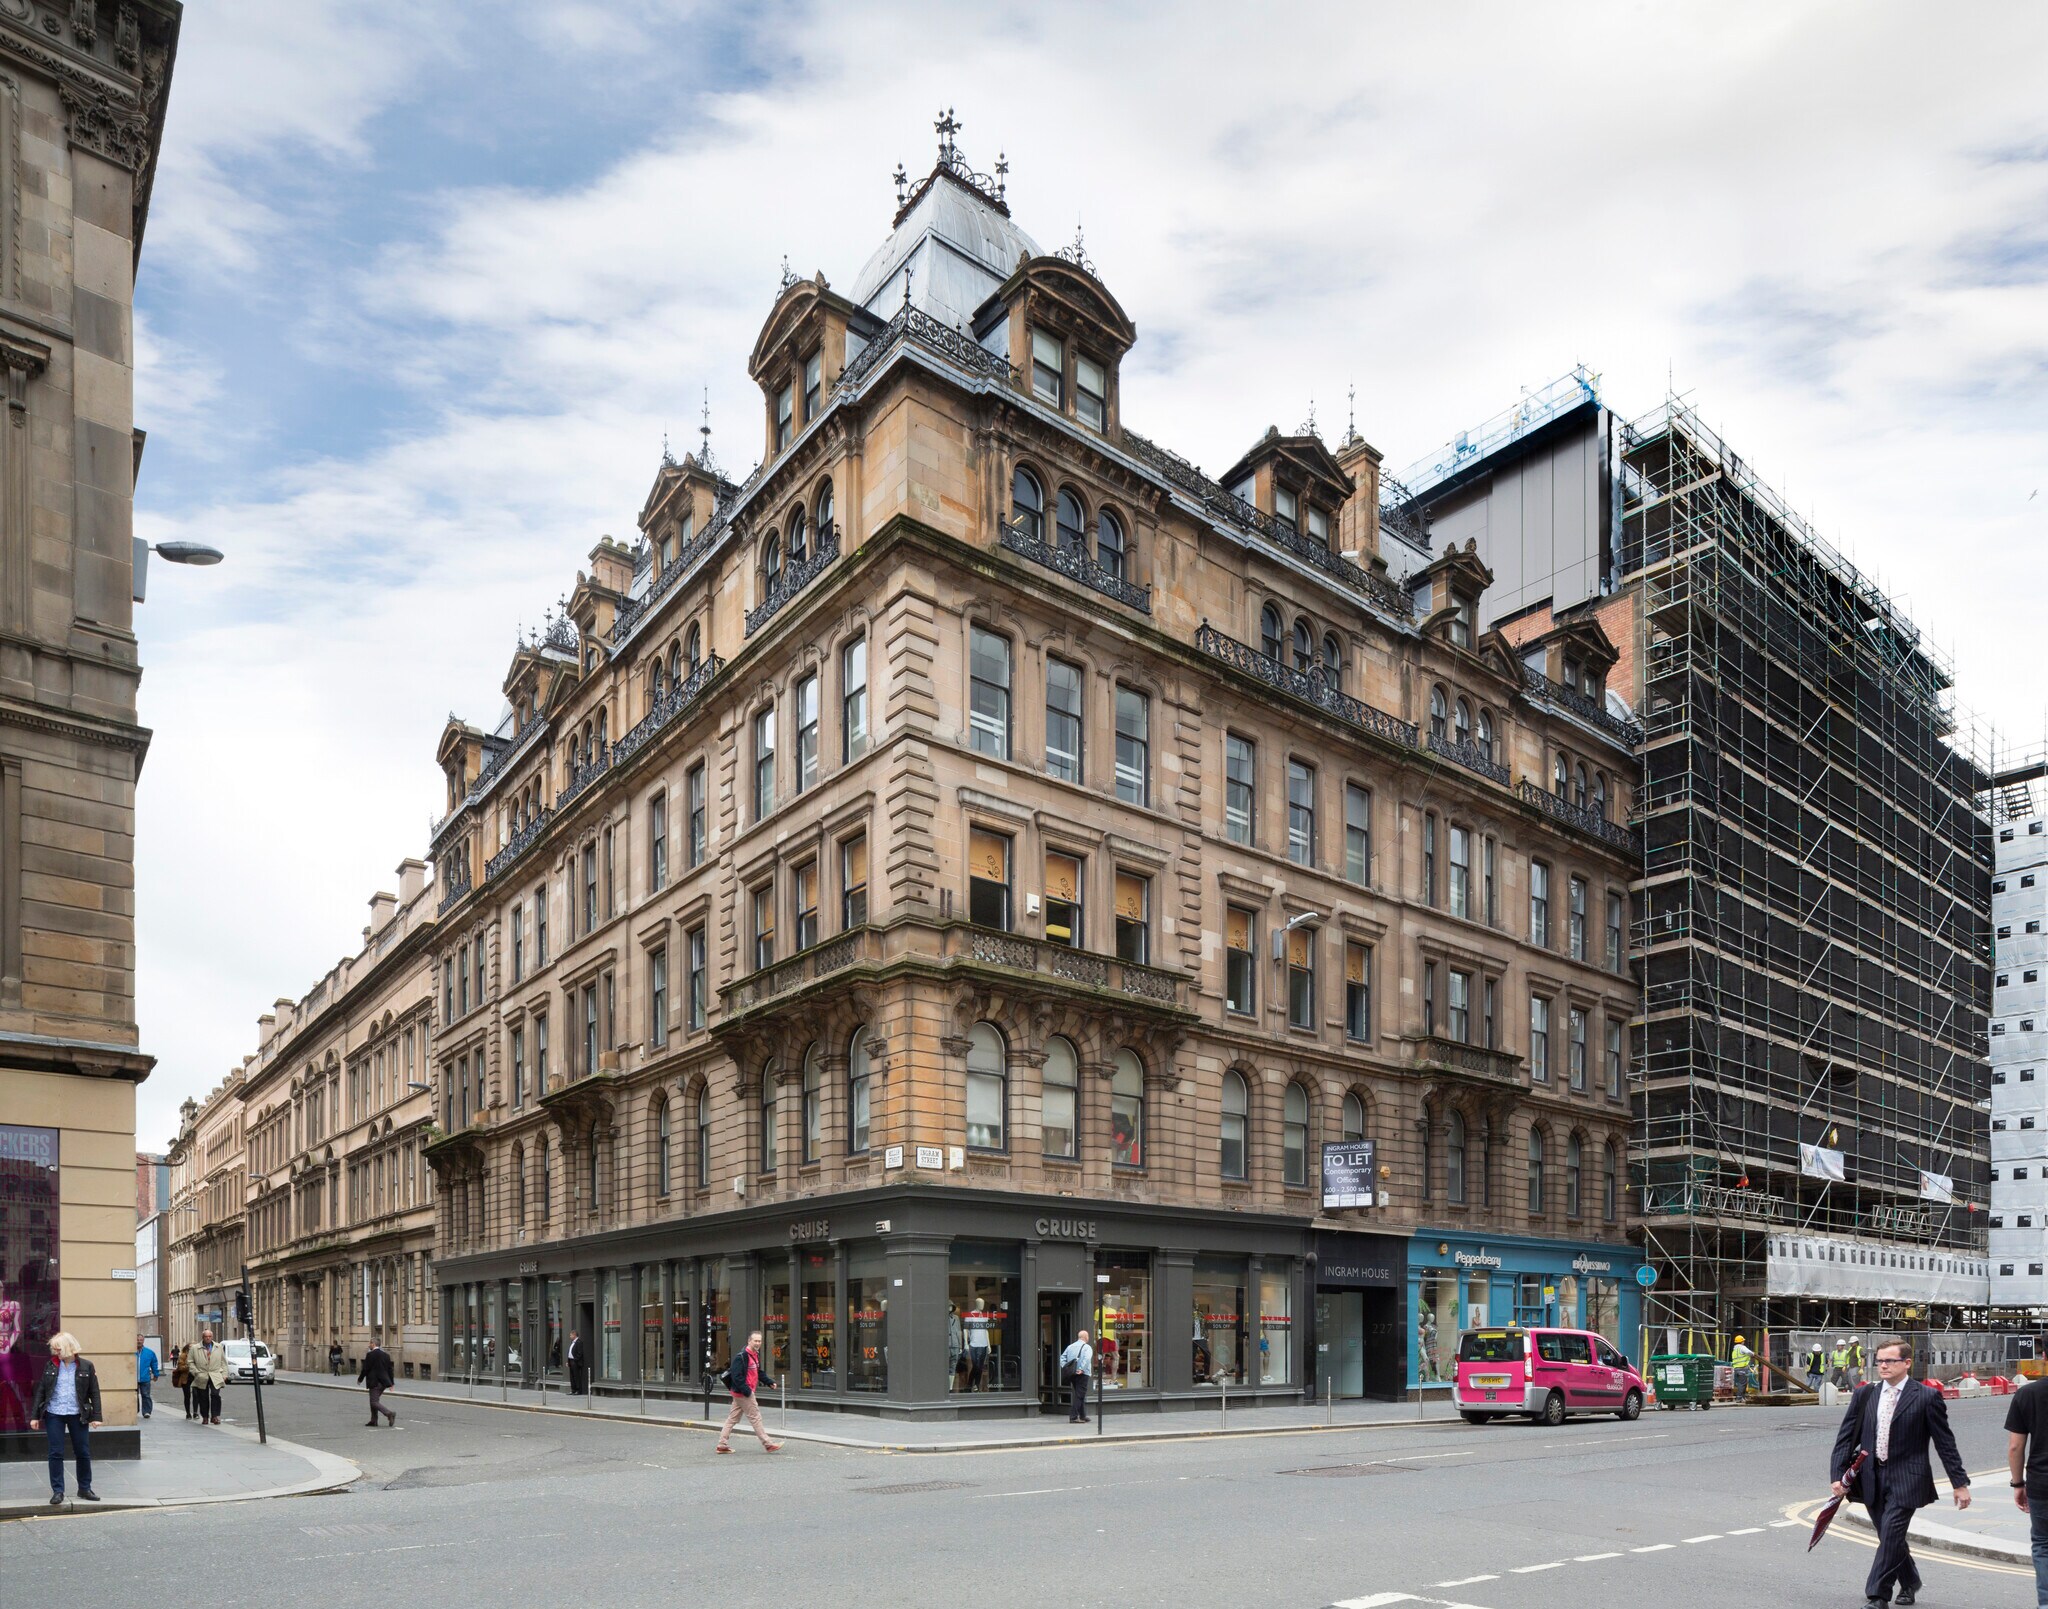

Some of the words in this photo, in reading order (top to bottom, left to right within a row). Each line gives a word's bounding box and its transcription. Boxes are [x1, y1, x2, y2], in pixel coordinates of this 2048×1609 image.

[920, 1149, 940, 1157] INGRAM
[1326, 1144, 1348, 1152] INGRAM
[1323, 1155, 1344, 1167] TO
[1348, 1153, 1371, 1166] LET
[1324, 1167, 1371, 1176] Contemporary
[1336, 1176, 1360, 1184] Offices
[789, 1220, 829, 1239] CRUISE
[1035, 1218, 1096, 1238] CRUISE
[1455, 1246, 1501, 1268] Pepperberry
[1325, 1266, 1359, 1278] INGRAM
[1362, 1267, 1390, 1279] HOUSE
[768, 1314, 784, 1323] SALE
[811, 1312, 829, 1322] SALE
[858, 1310, 877, 1320] SALE
[970, 1310, 998, 1320] SALE
[1113, 1312, 1137, 1321] SALE
[1211, 1313, 1232, 1322] SALE
[1372, 1323, 1393, 1334] 227
